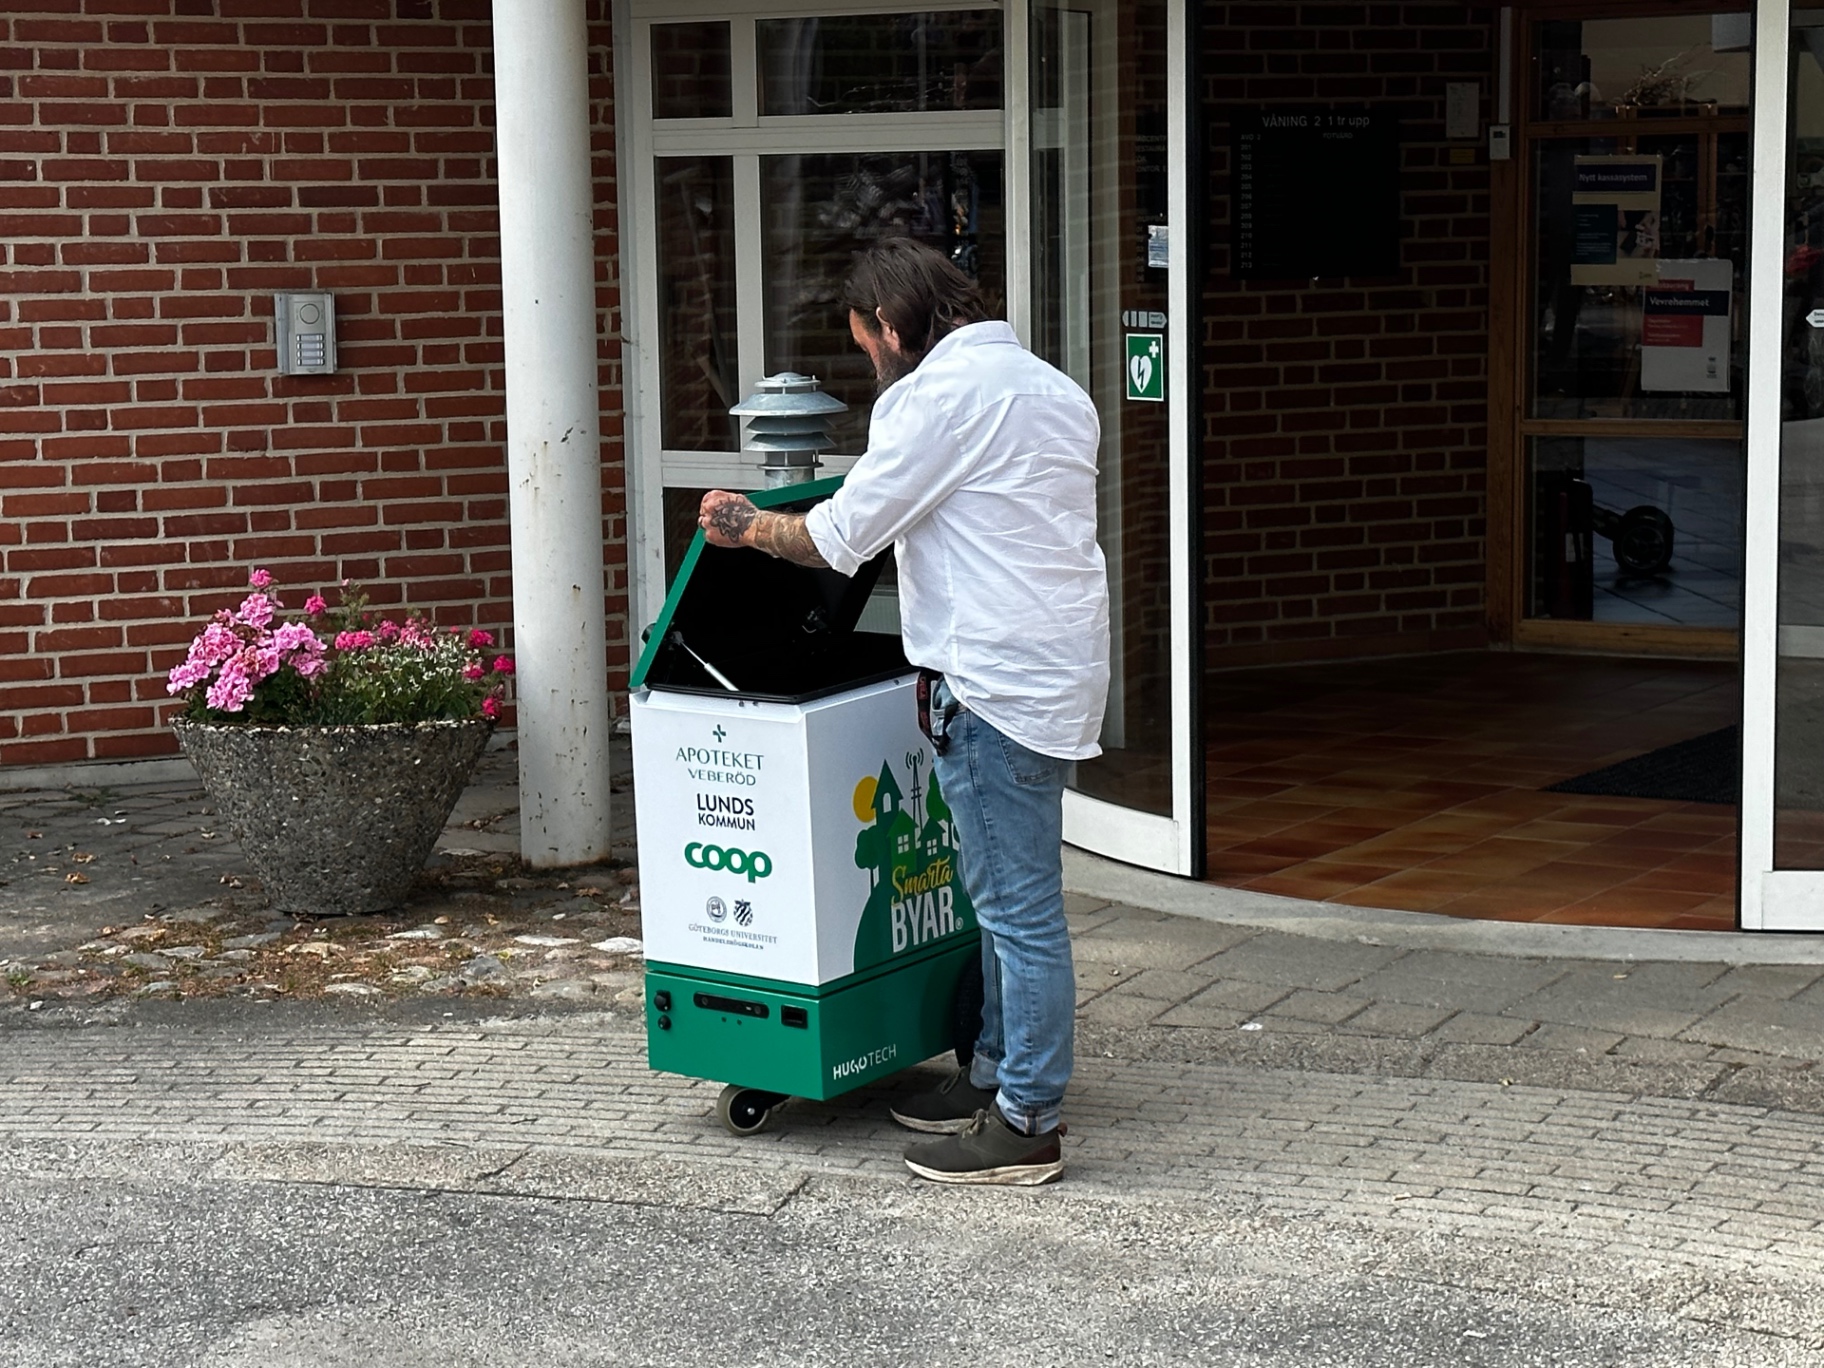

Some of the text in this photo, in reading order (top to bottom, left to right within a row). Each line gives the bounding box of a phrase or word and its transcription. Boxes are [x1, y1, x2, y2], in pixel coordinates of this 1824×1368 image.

[1262, 113, 1370, 128] VÅNING 2 1 tr upp
[1578, 173, 1648, 183] Nytt kassasystem
[676, 746, 764, 771] APOTEKET
[688, 768, 757, 786] VEBERÖD
[696, 793, 755, 816] LUNDS
[698, 813, 756, 831] KOMMUN
[684, 841, 773, 884] coop
[891, 855, 954, 907] Smarta
[688, 922, 778, 945] GÖTEBORGS UNIVERSITET
